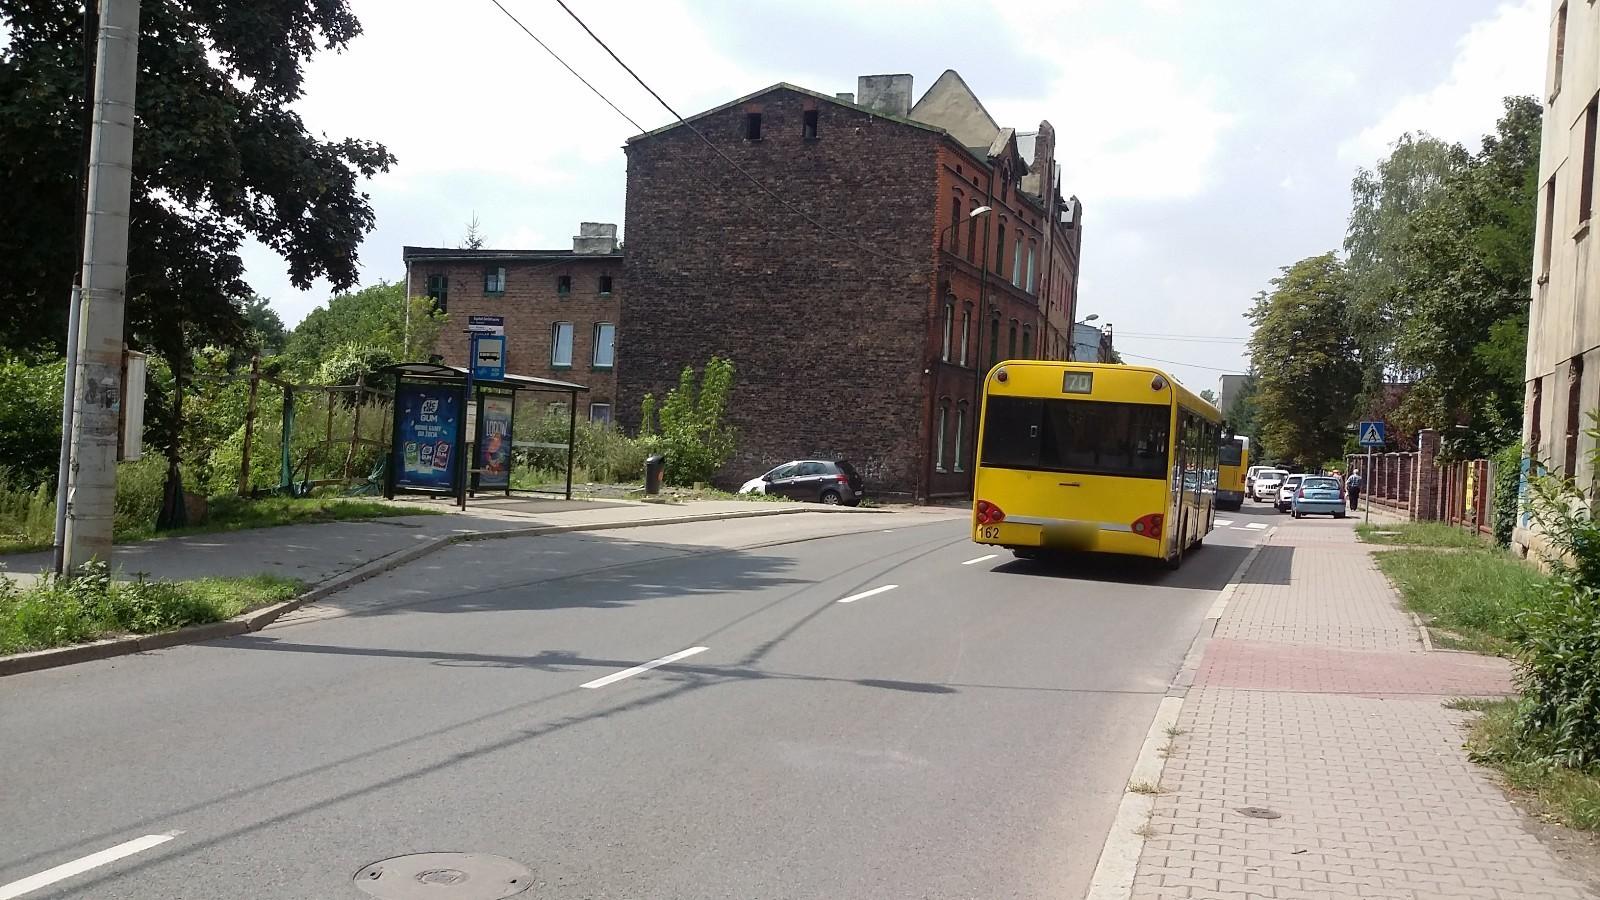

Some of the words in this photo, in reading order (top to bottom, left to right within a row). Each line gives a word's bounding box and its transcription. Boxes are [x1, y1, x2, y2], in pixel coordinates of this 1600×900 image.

[1069, 375, 1089, 391] 70
[420, 414, 438, 423] GUM
[978, 526, 1000, 539] 162
